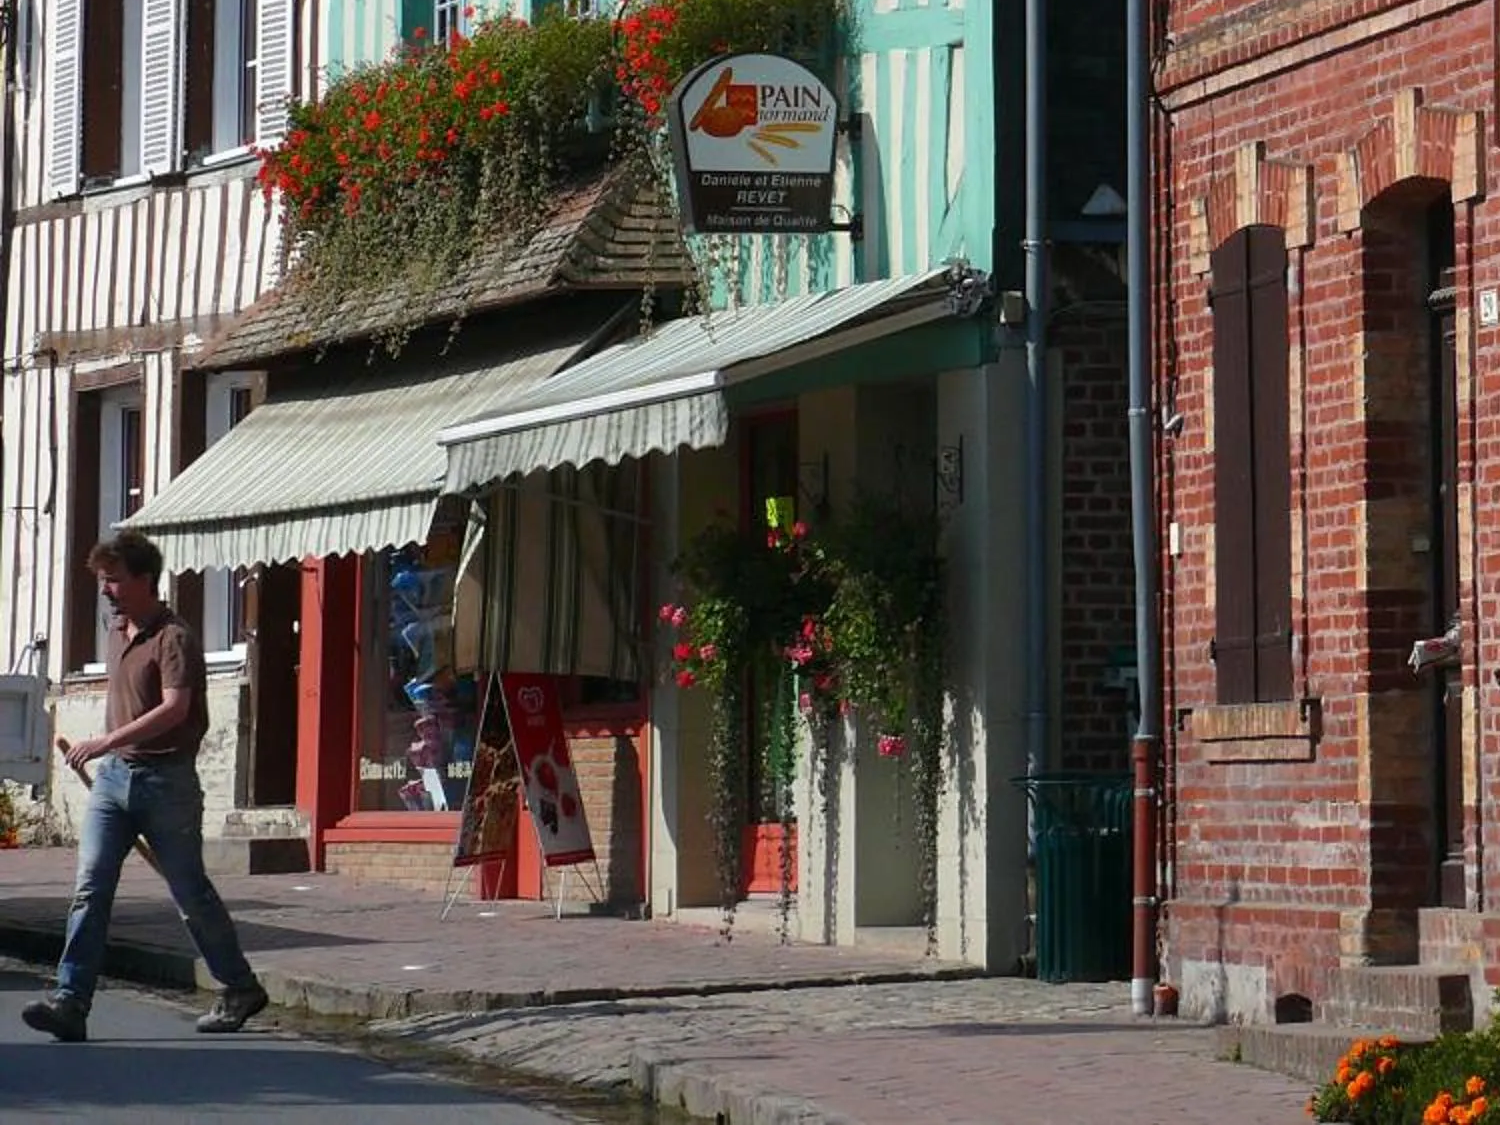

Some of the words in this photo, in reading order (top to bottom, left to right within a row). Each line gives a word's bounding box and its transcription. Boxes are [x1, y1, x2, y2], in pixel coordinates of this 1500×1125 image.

[761, 85, 821, 108] PAIN
[757, 106, 832, 123] normand
[755, 175, 768, 186] et
[735, 190, 788, 204] REVET
